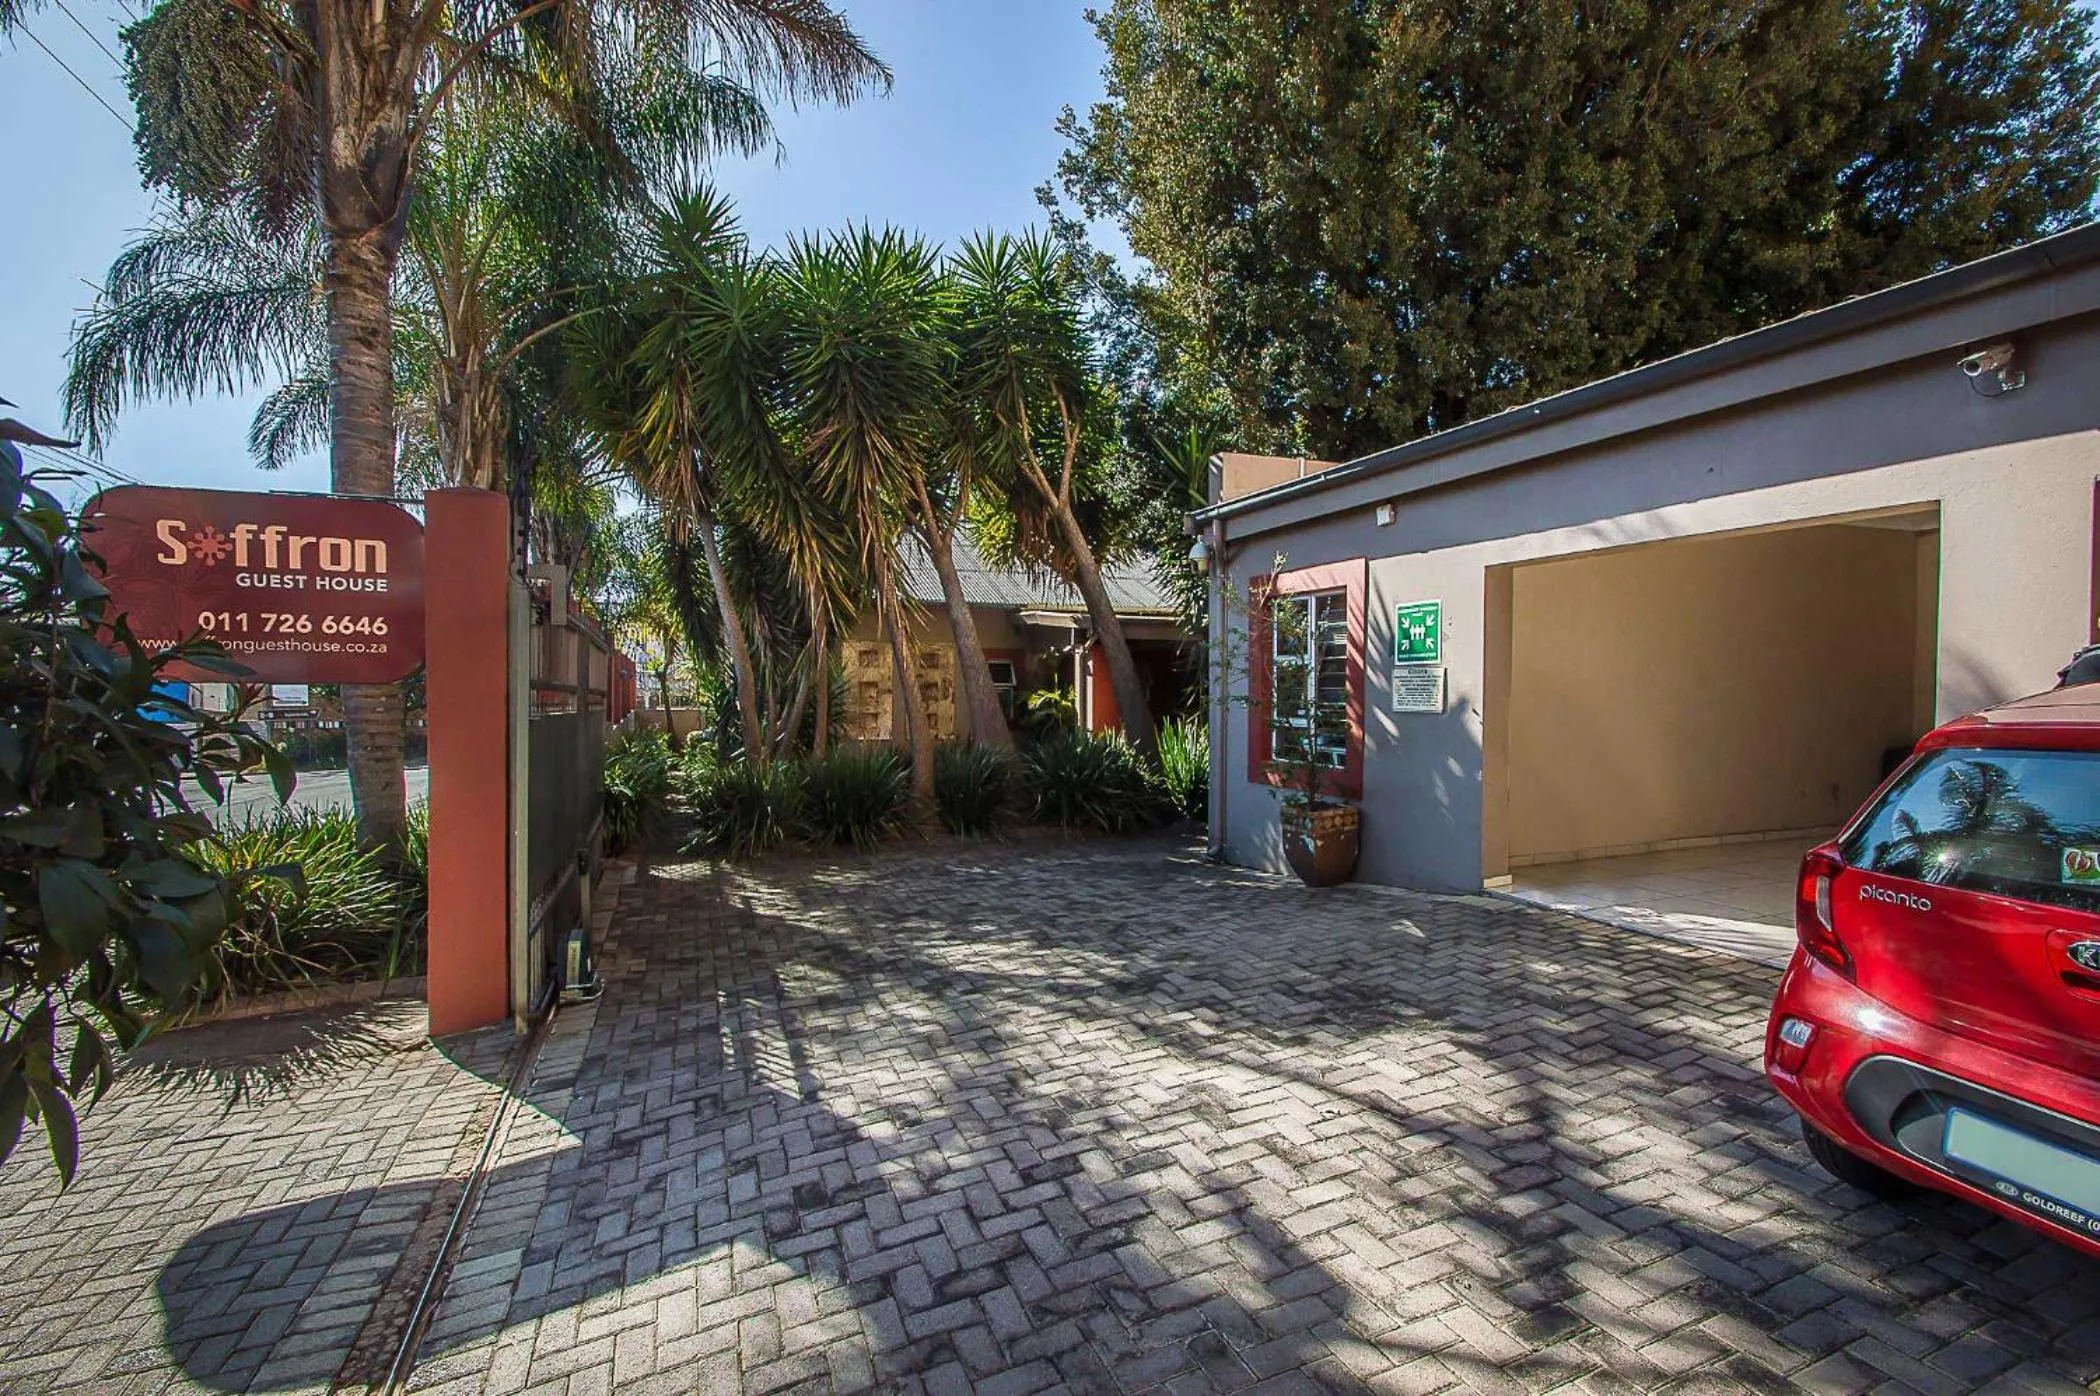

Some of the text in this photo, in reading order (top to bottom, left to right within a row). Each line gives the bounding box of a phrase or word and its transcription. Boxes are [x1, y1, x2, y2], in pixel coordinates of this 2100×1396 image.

[235, 572, 388, 592] GUEST HOUSE
[198, 611, 388, 636] 011 726 6646
[137, 635, 388, 654] wwwonguesthouse.co.za
[1859, 884, 1932, 911] picanto
[2023, 1191, 2085, 1224] GOLDREEF
